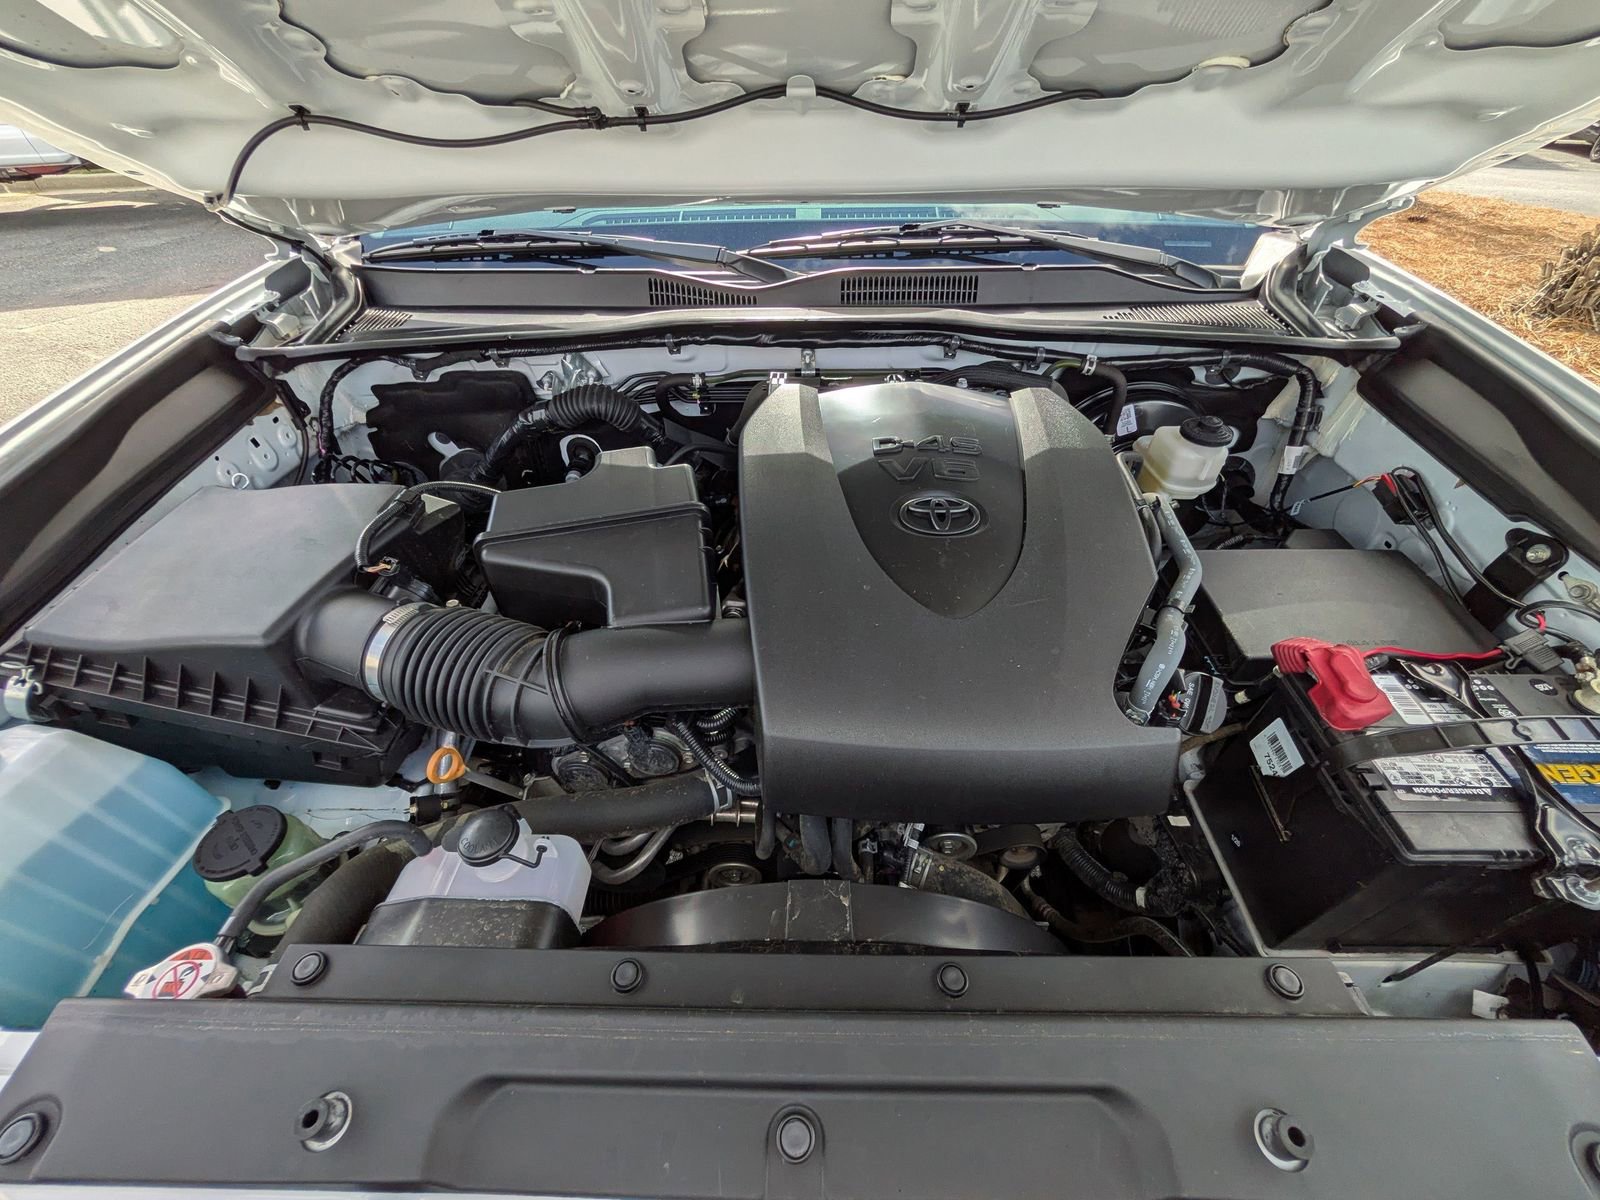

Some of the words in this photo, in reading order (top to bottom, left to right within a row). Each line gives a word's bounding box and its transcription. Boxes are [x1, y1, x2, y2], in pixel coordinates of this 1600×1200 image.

[872, 434, 982, 456] D-4S
[878, 457, 981, 482] V6
[1264, 752, 1280, 777] 7524
[1536, 763, 1600, 785] GEN
